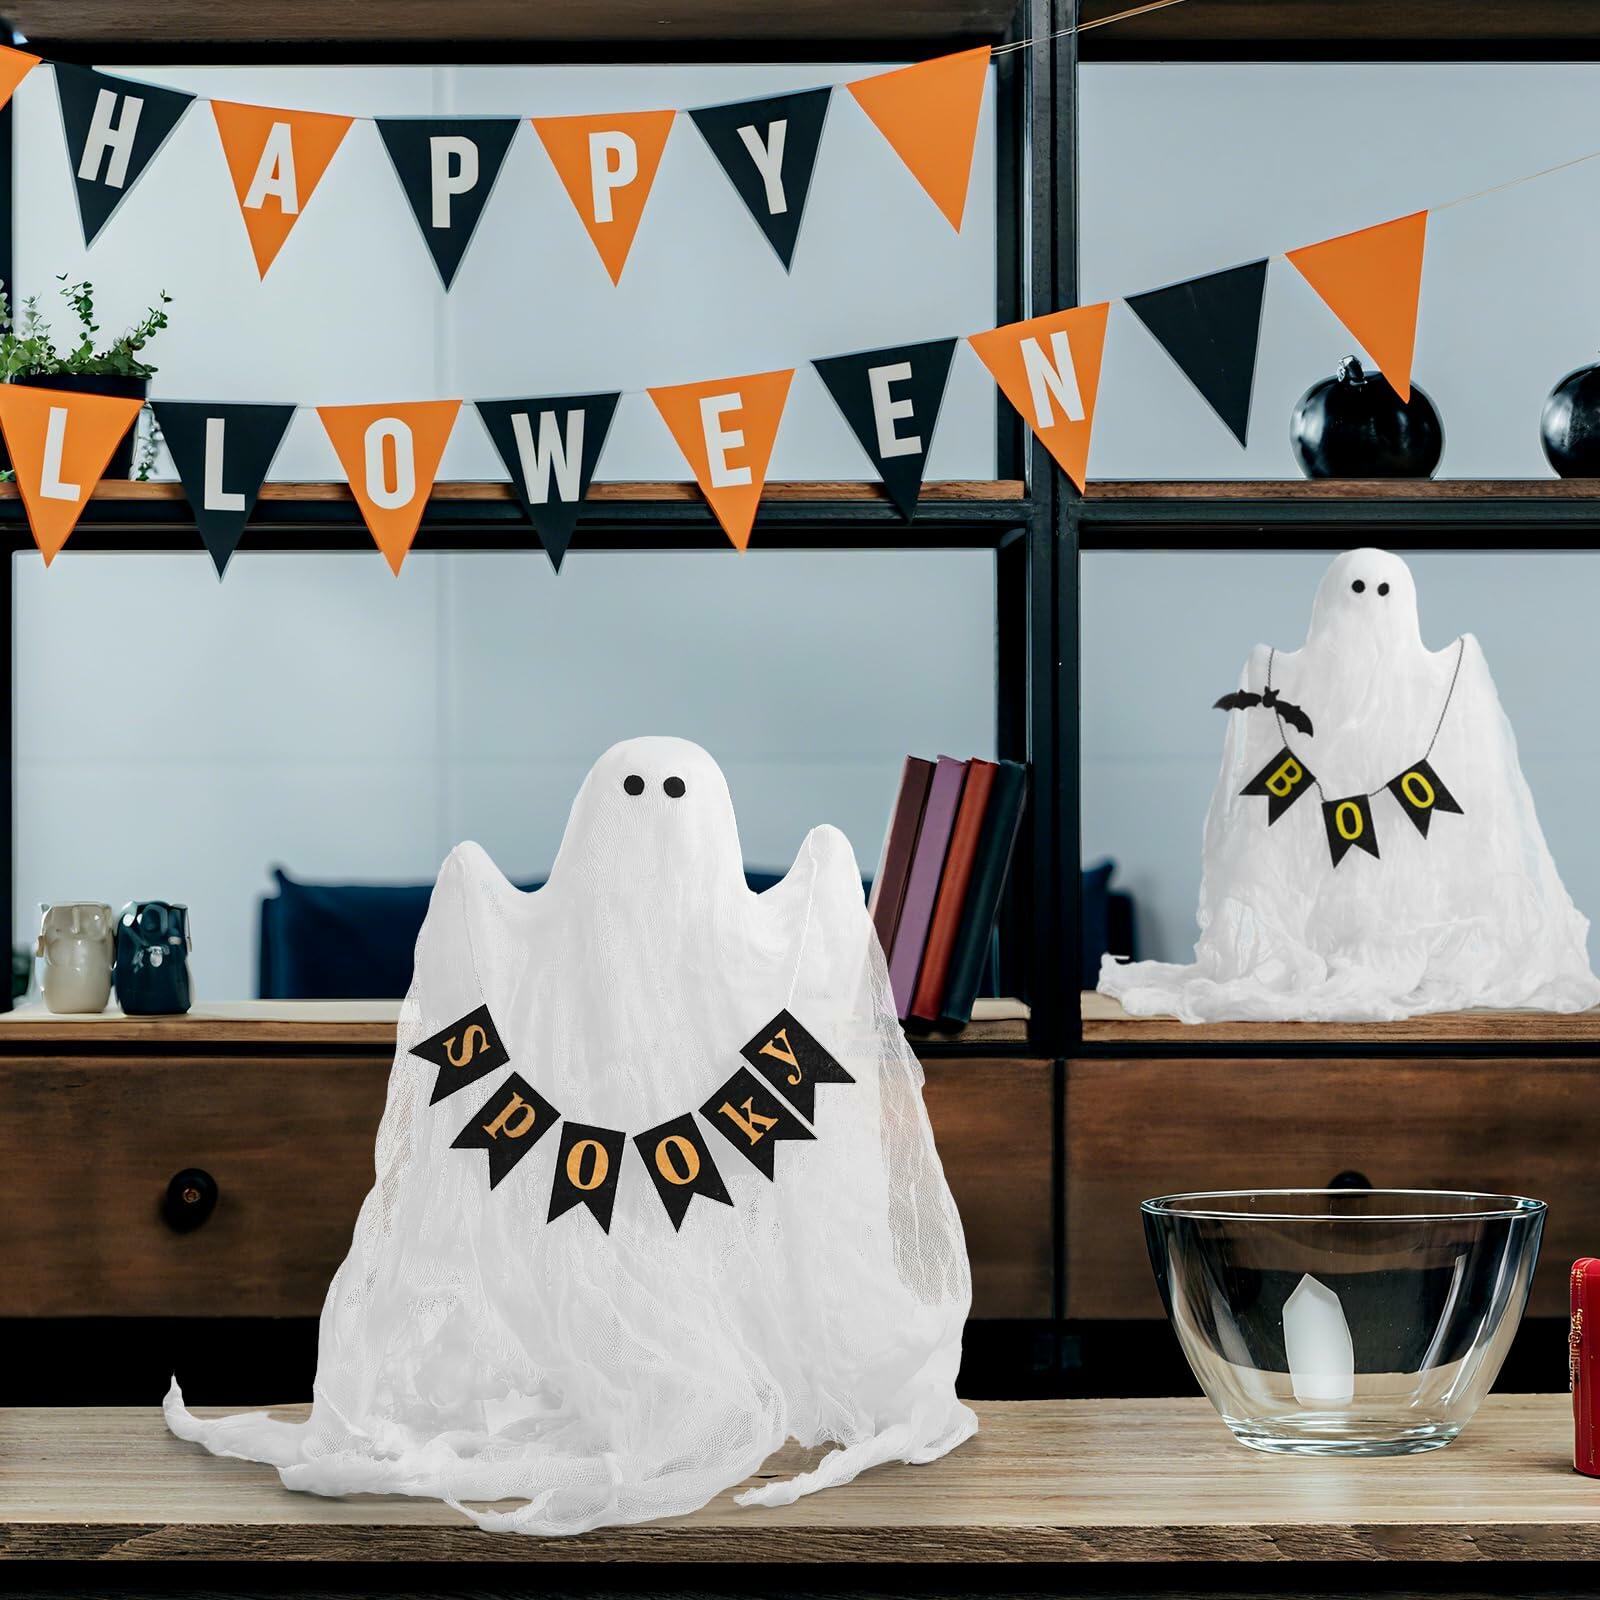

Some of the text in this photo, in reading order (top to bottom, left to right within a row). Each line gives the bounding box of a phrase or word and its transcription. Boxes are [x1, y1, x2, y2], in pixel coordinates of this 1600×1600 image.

[78, 88, 789, 229] HAPPY
[39, 330, 1086, 512] LLOWEEN
[1264, 757, 1435, 840] BOO
